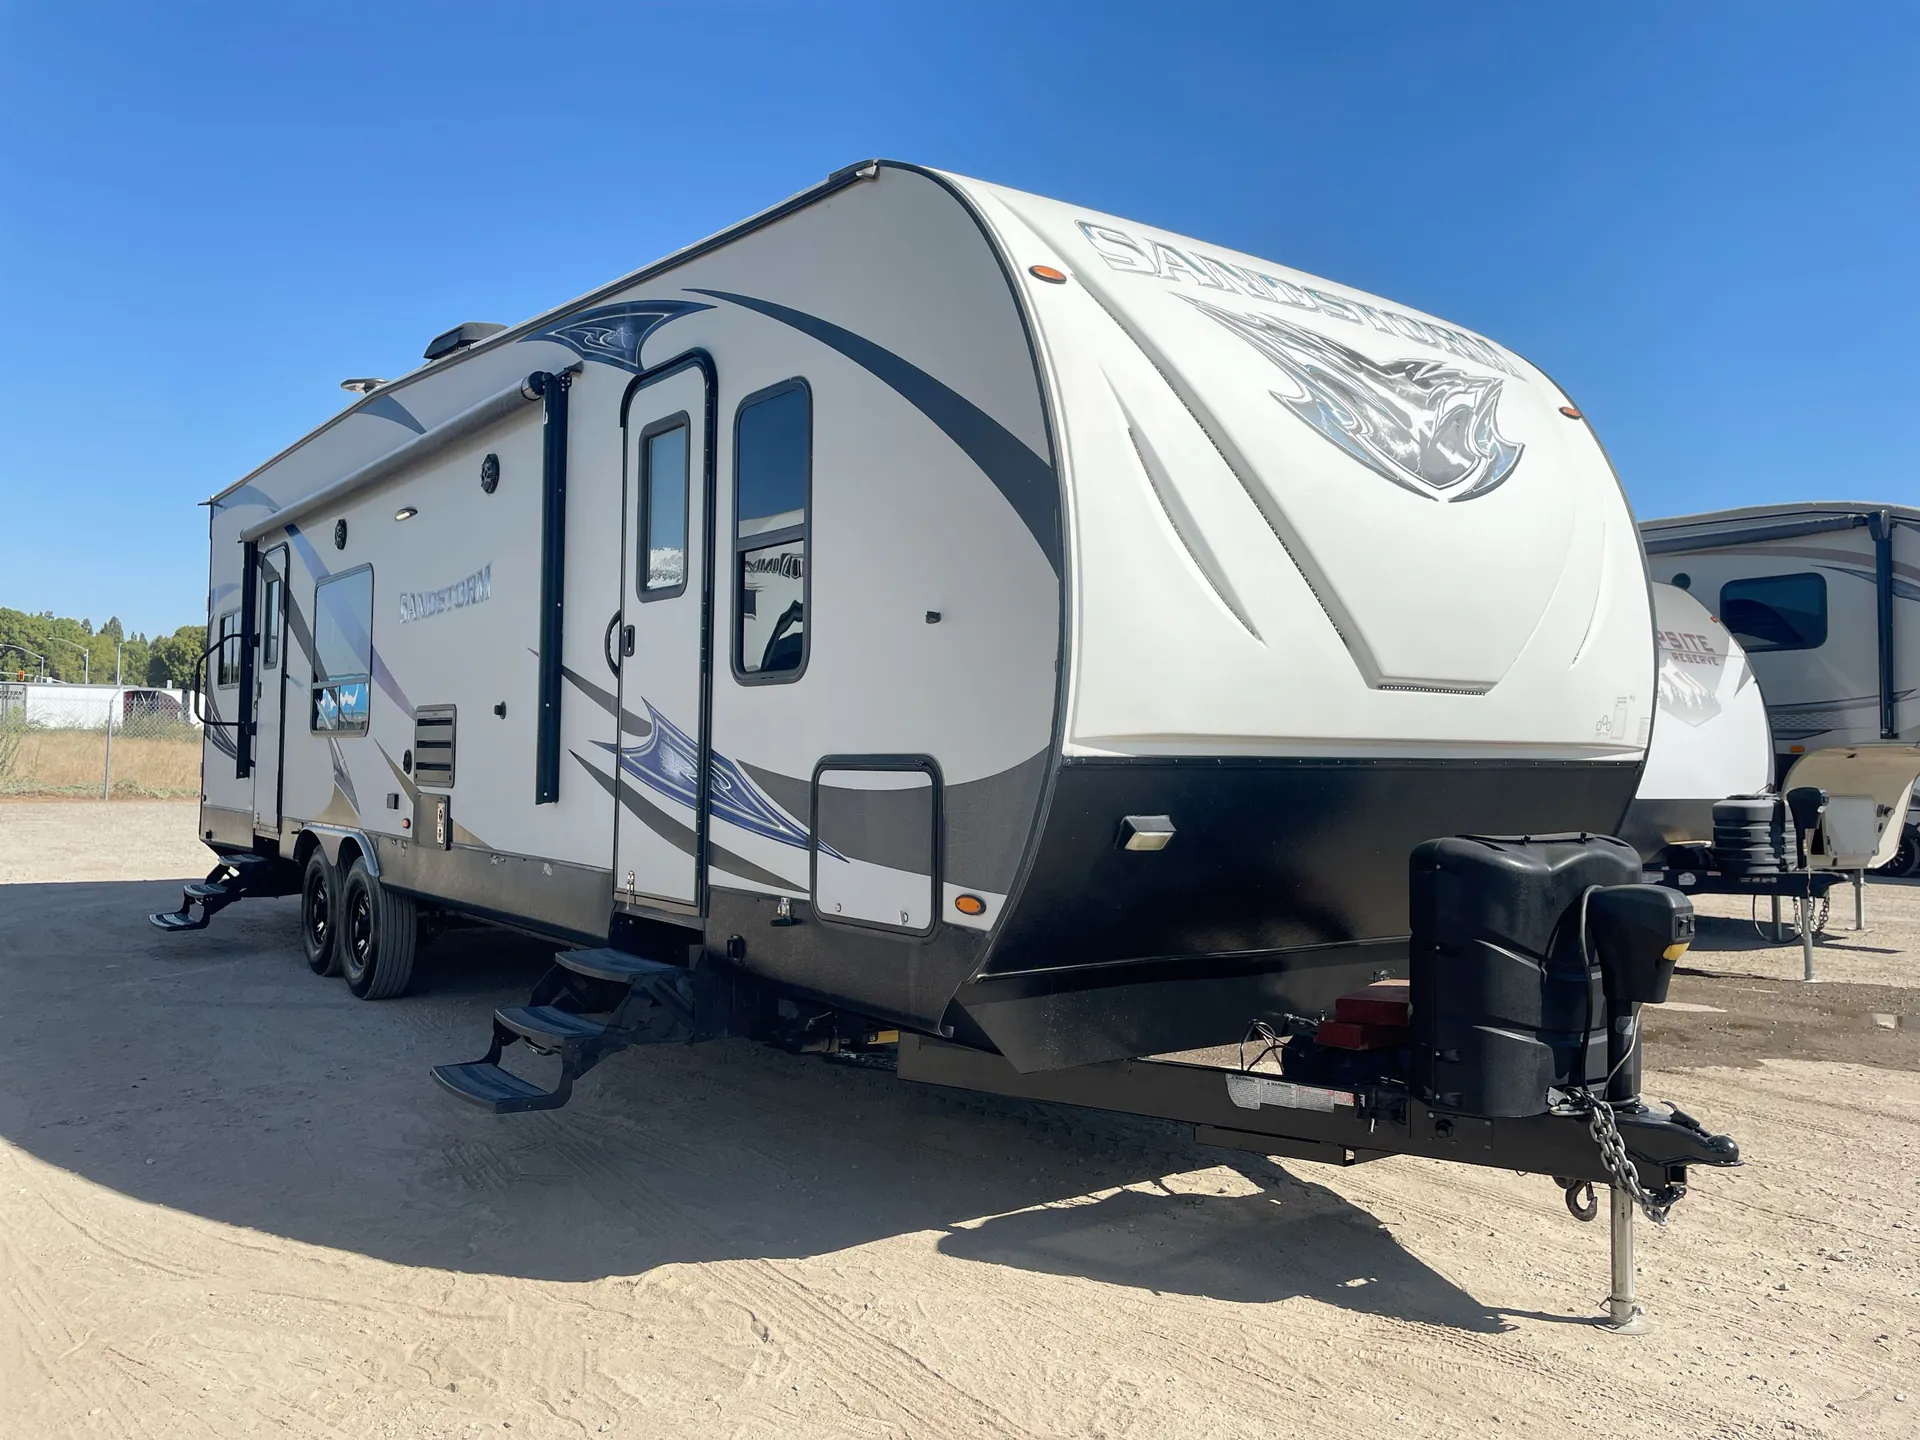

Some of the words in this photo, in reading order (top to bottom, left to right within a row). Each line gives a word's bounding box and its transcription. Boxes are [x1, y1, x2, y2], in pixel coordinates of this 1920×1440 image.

[1075, 219, 1527, 382] SANDSTORM
[399, 561, 492, 624] SANDSTORM
[1672, 652, 1719, 666] RESERVE
